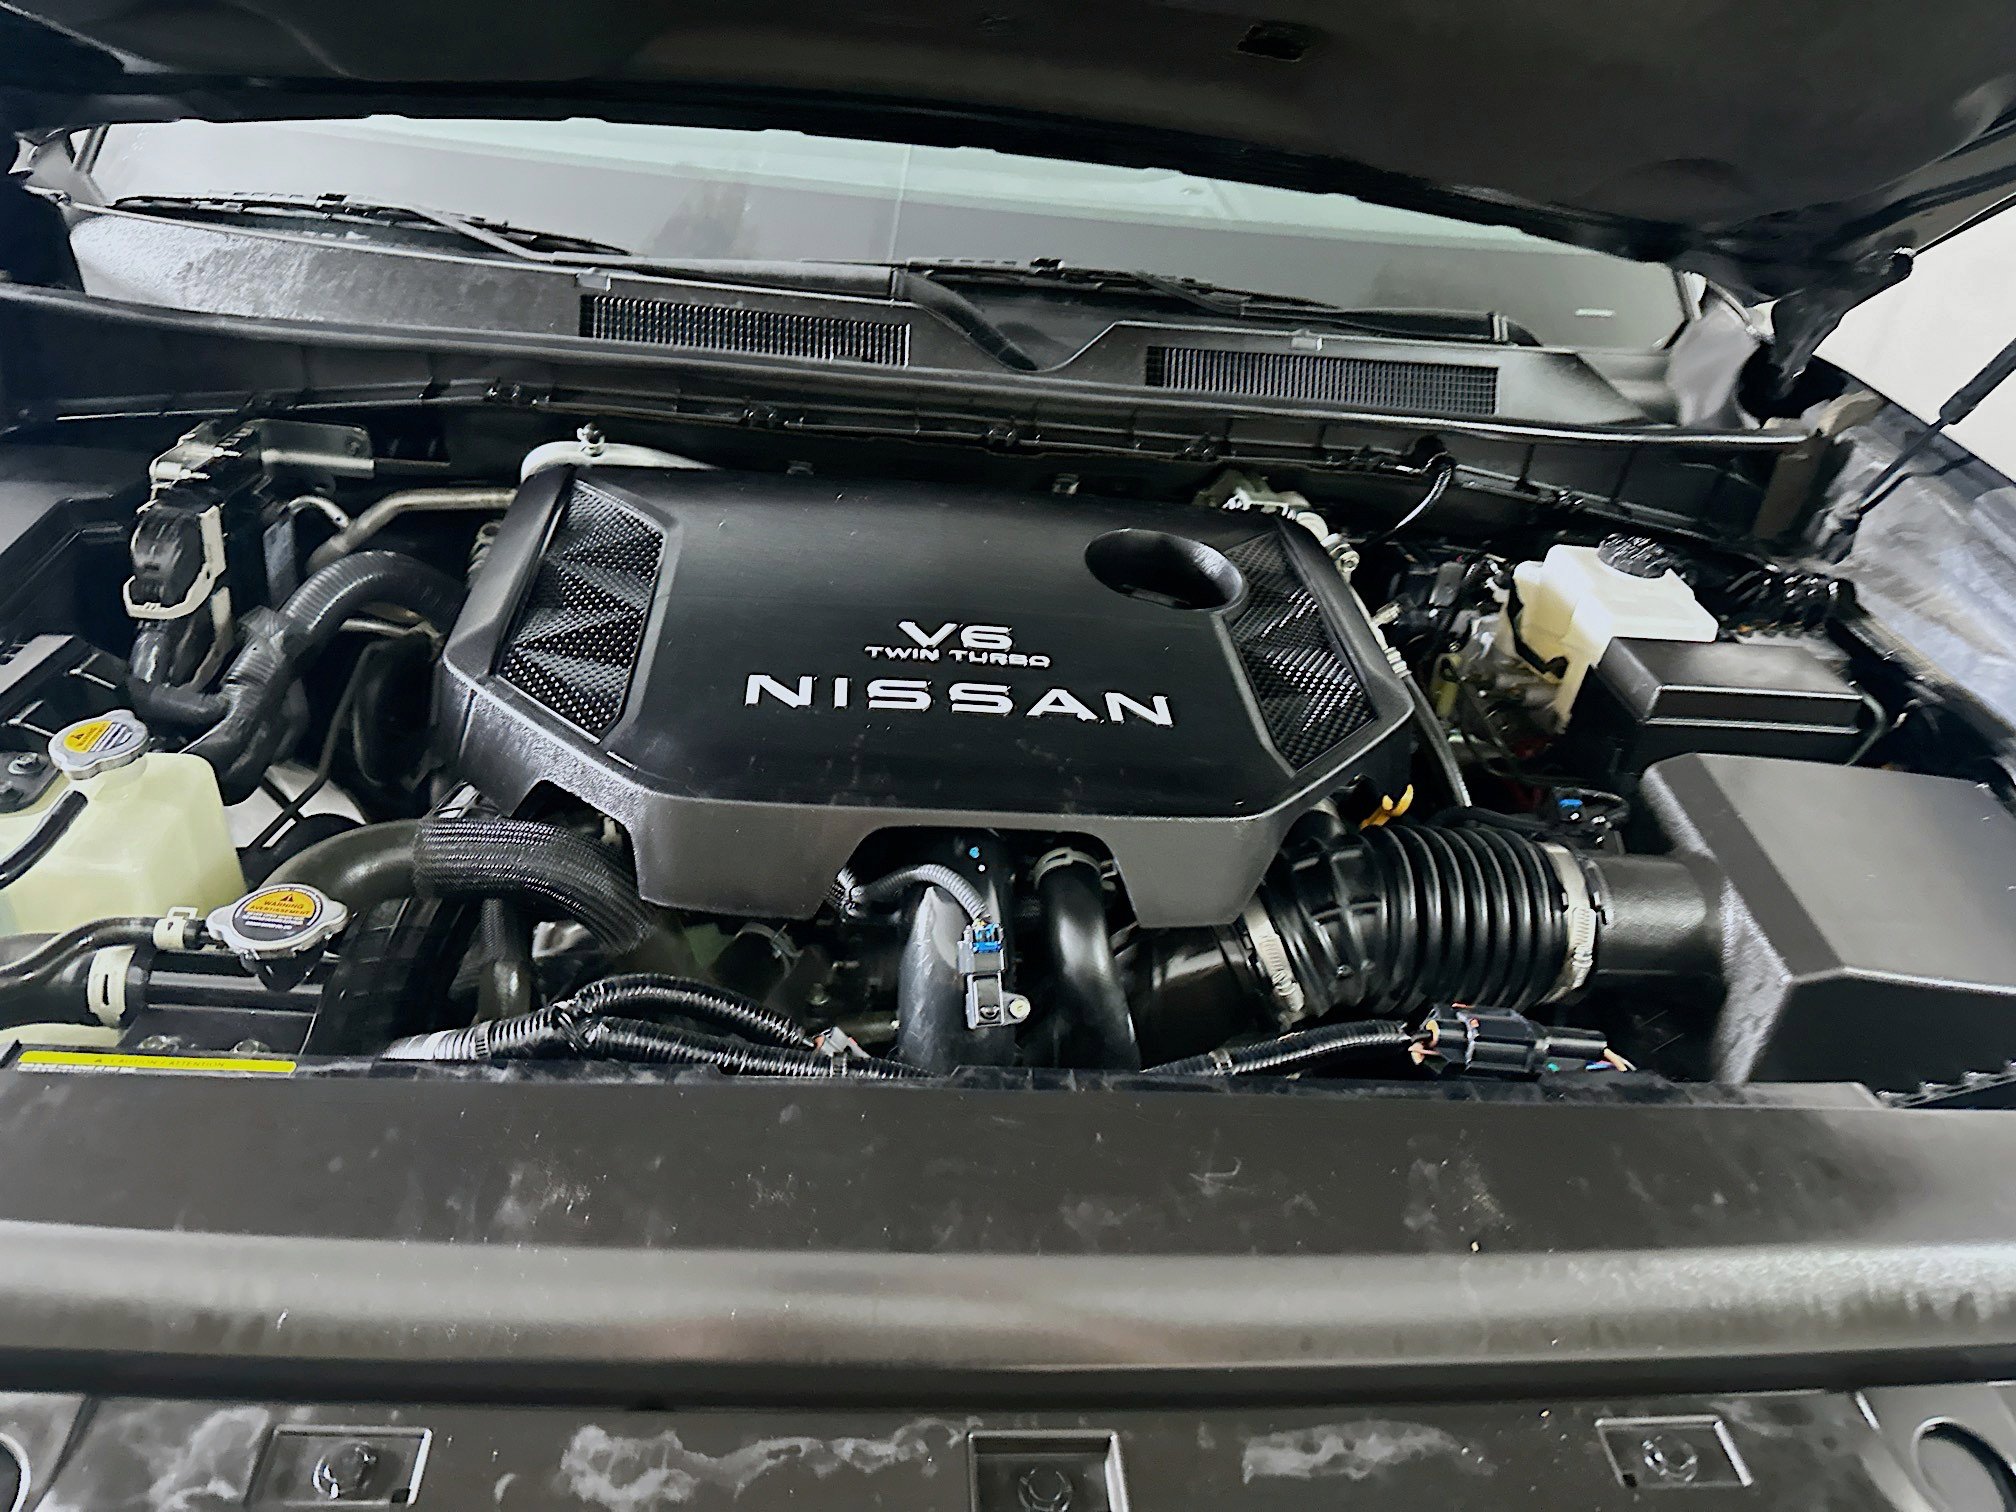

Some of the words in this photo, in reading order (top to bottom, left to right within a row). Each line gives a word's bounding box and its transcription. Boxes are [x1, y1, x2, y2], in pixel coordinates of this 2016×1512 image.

[898, 621, 1013, 651] V6
[864, 646, 940, 662] TWIN
[948, 648, 1051, 668] TURBO
[744, 674, 1175, 728] NISSAN
[264, 900, 304, 910] WARNING
